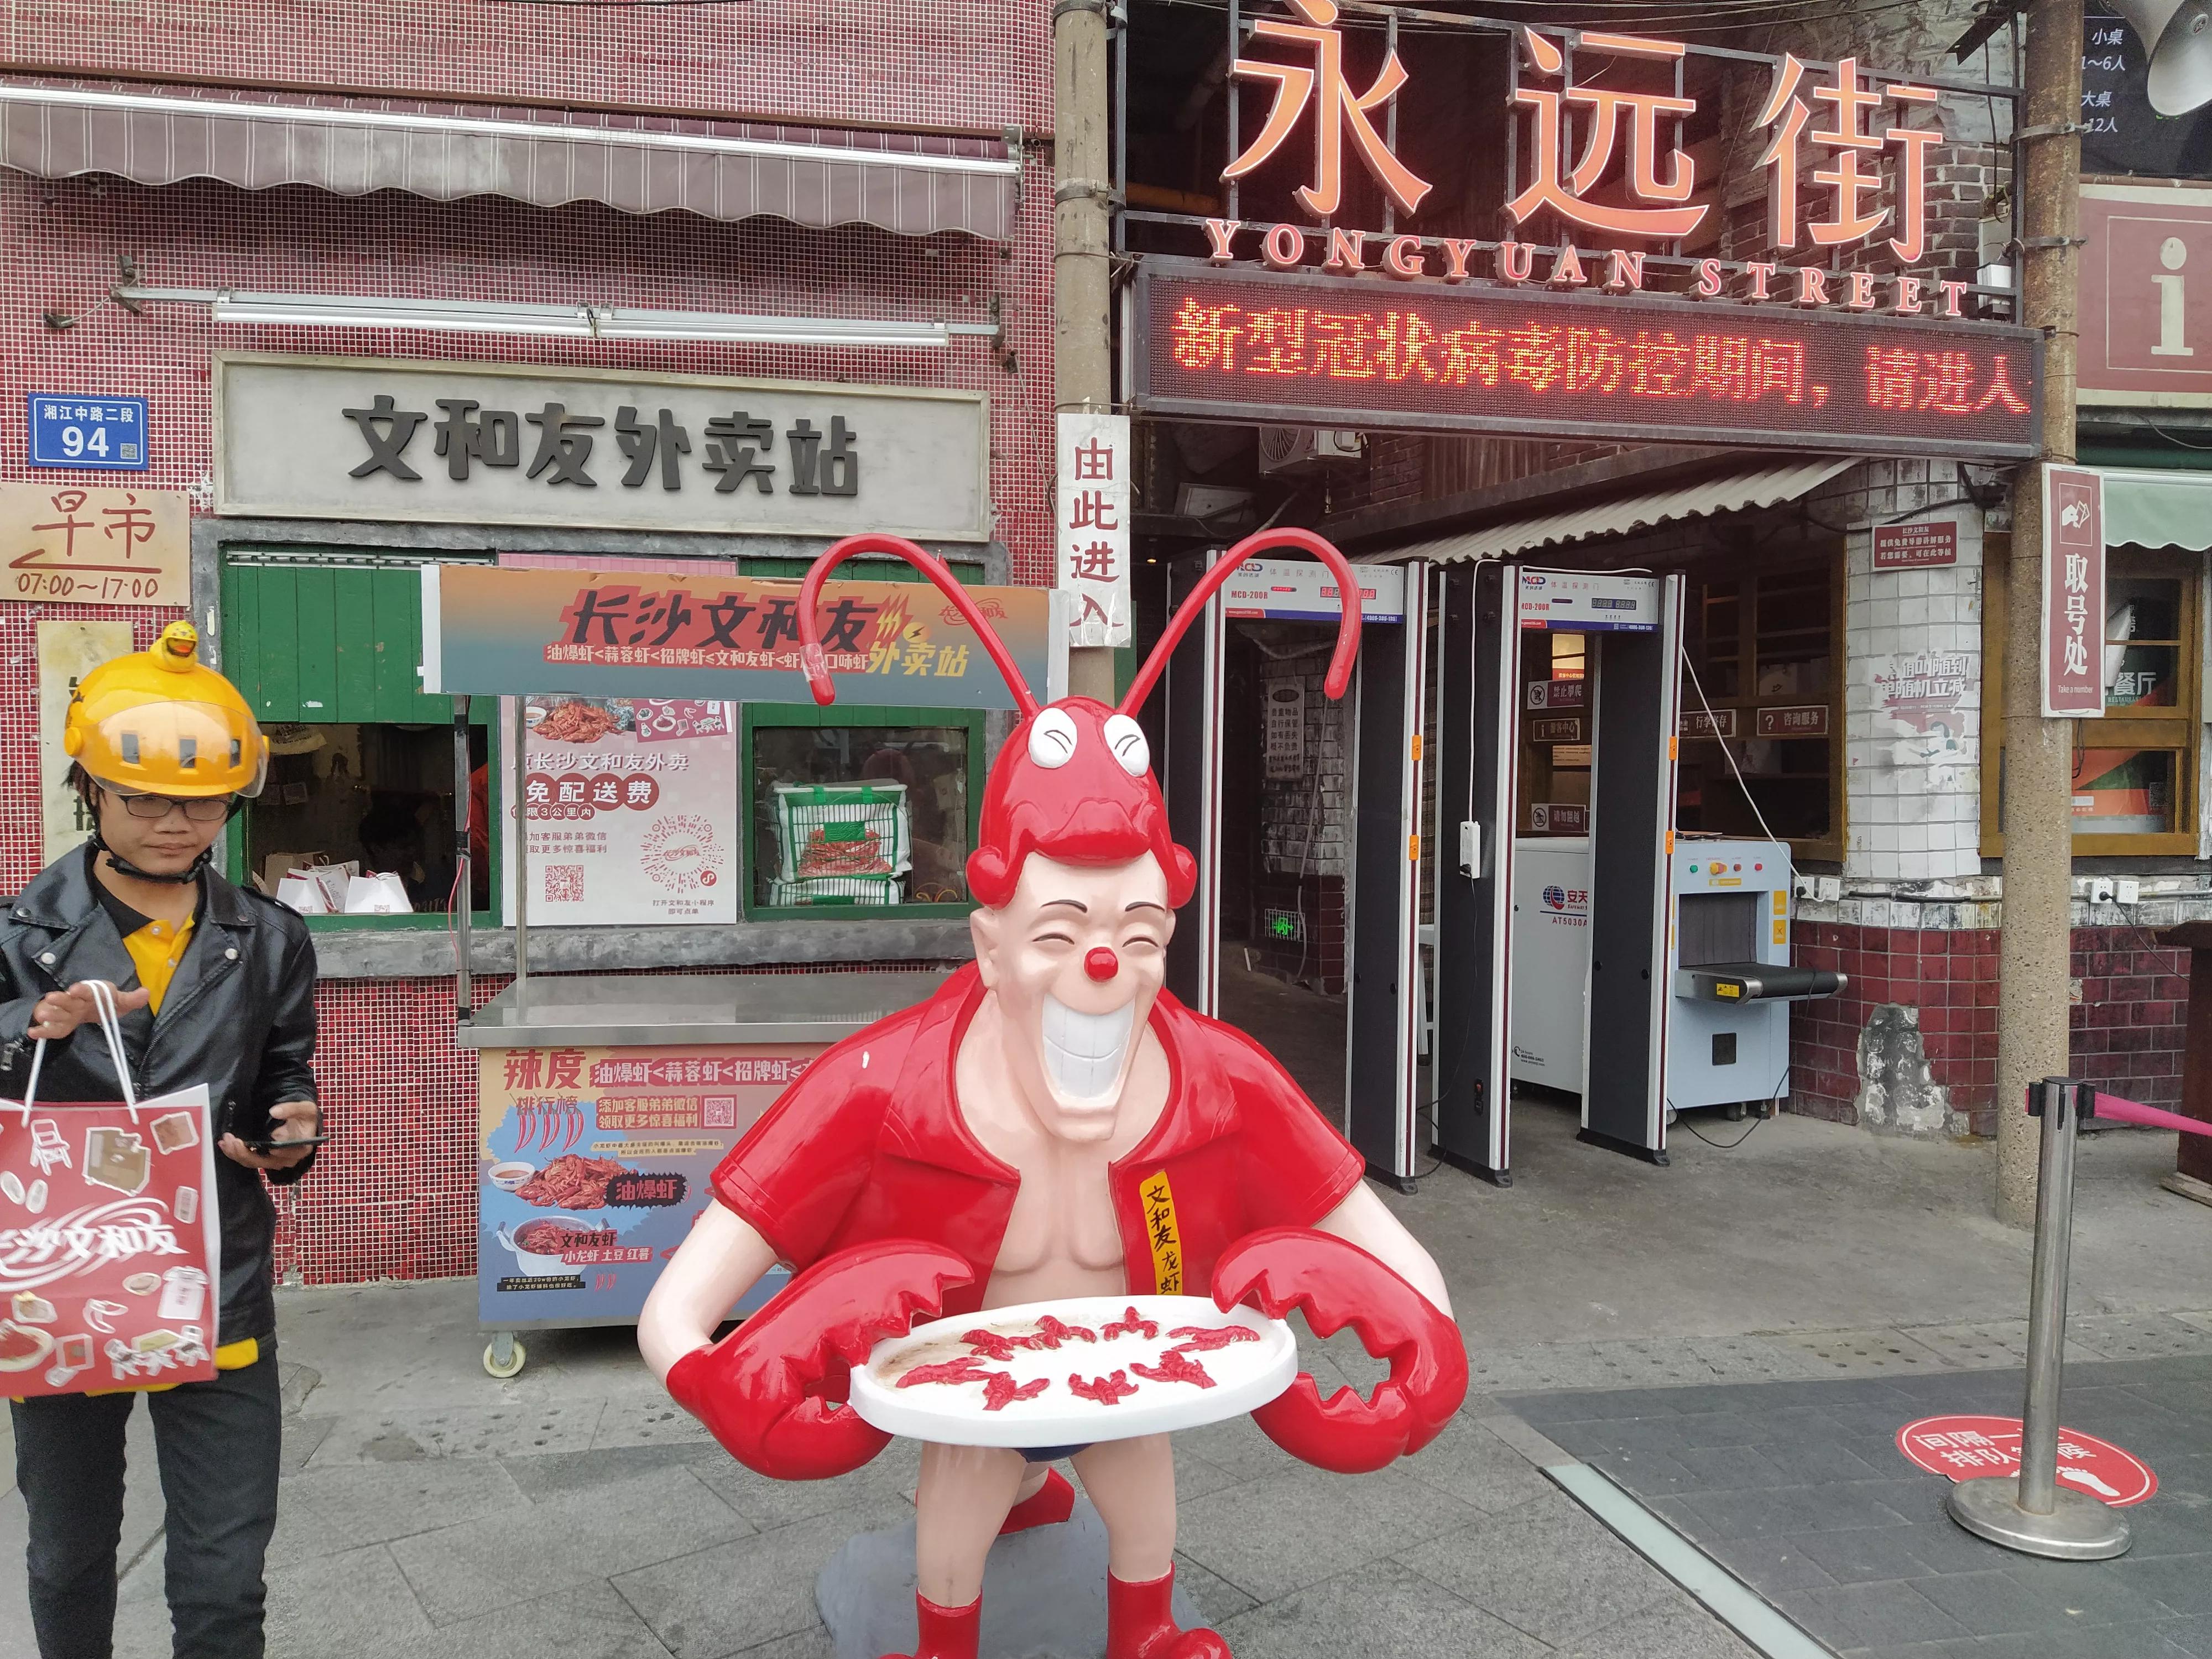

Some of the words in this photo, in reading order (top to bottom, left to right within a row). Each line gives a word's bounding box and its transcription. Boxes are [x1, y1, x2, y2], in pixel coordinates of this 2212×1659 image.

[2092, 28, 2124, 45] 小桌
[2081, 90, 2112, 107] 大桌
[1222, 0, 1943, 263] 永远街
[1204, 217, 1646, 291] YONGYUAN
[1697, 258, 1970, 318] STREET
[44, 404, 134, 424] 湘江中路二段
[62, 426, 109, 457] 94
[342, 394, 858, 497] 文和友外卖站
[32, 491, 156, 560] 早市
[1069, 437, 1124, 627] 由此进入
[1231, 590, 1268, 599] MCD-200R
[572, 590, 878, 653] 长沙文和友
[2064, 554, 2089, 676] 取号处
[866, 642, 969, 677] 外卖站
[1553, 684, 1582, 698] 禁止攀爬
[2058, 685, 2070, 693] Take
[2114, 672, 2157, 696] 餐厅
[1271, 719, 1298, 728] 自行保管
[1784, 711, 1819, 726] 咨询服务
[526, 780, 651, 805] 免配送费
[513, 807, 591, 817] 限3公里内
[1553, 810, 1580, 823] 请勿翻越
[525, 831, 607, 842] 加客服弟弟微信
[525, 844, 607, 854] 取更多惊喜福利
[504, 1048, 586, 1091] 辣度
[517, 1095, 578, 1116] 排行榜
[598, 1097, 698, 1112] 添加客服弟弟微信
[598, 1113, 698, 1129] 领取更多惊喜福利
[615, 1178, 677, 1201] 油爆虾
[561, 1231, 617, 1247] 文和友虾
[1146, 1185, 1181, 1295] 文和友龙虾
[565, 1248, 599, 1263] 小龙虾
[601, 1248, 624, 1261] 土豆
[627, 1247, 651, 1261] 红薯
